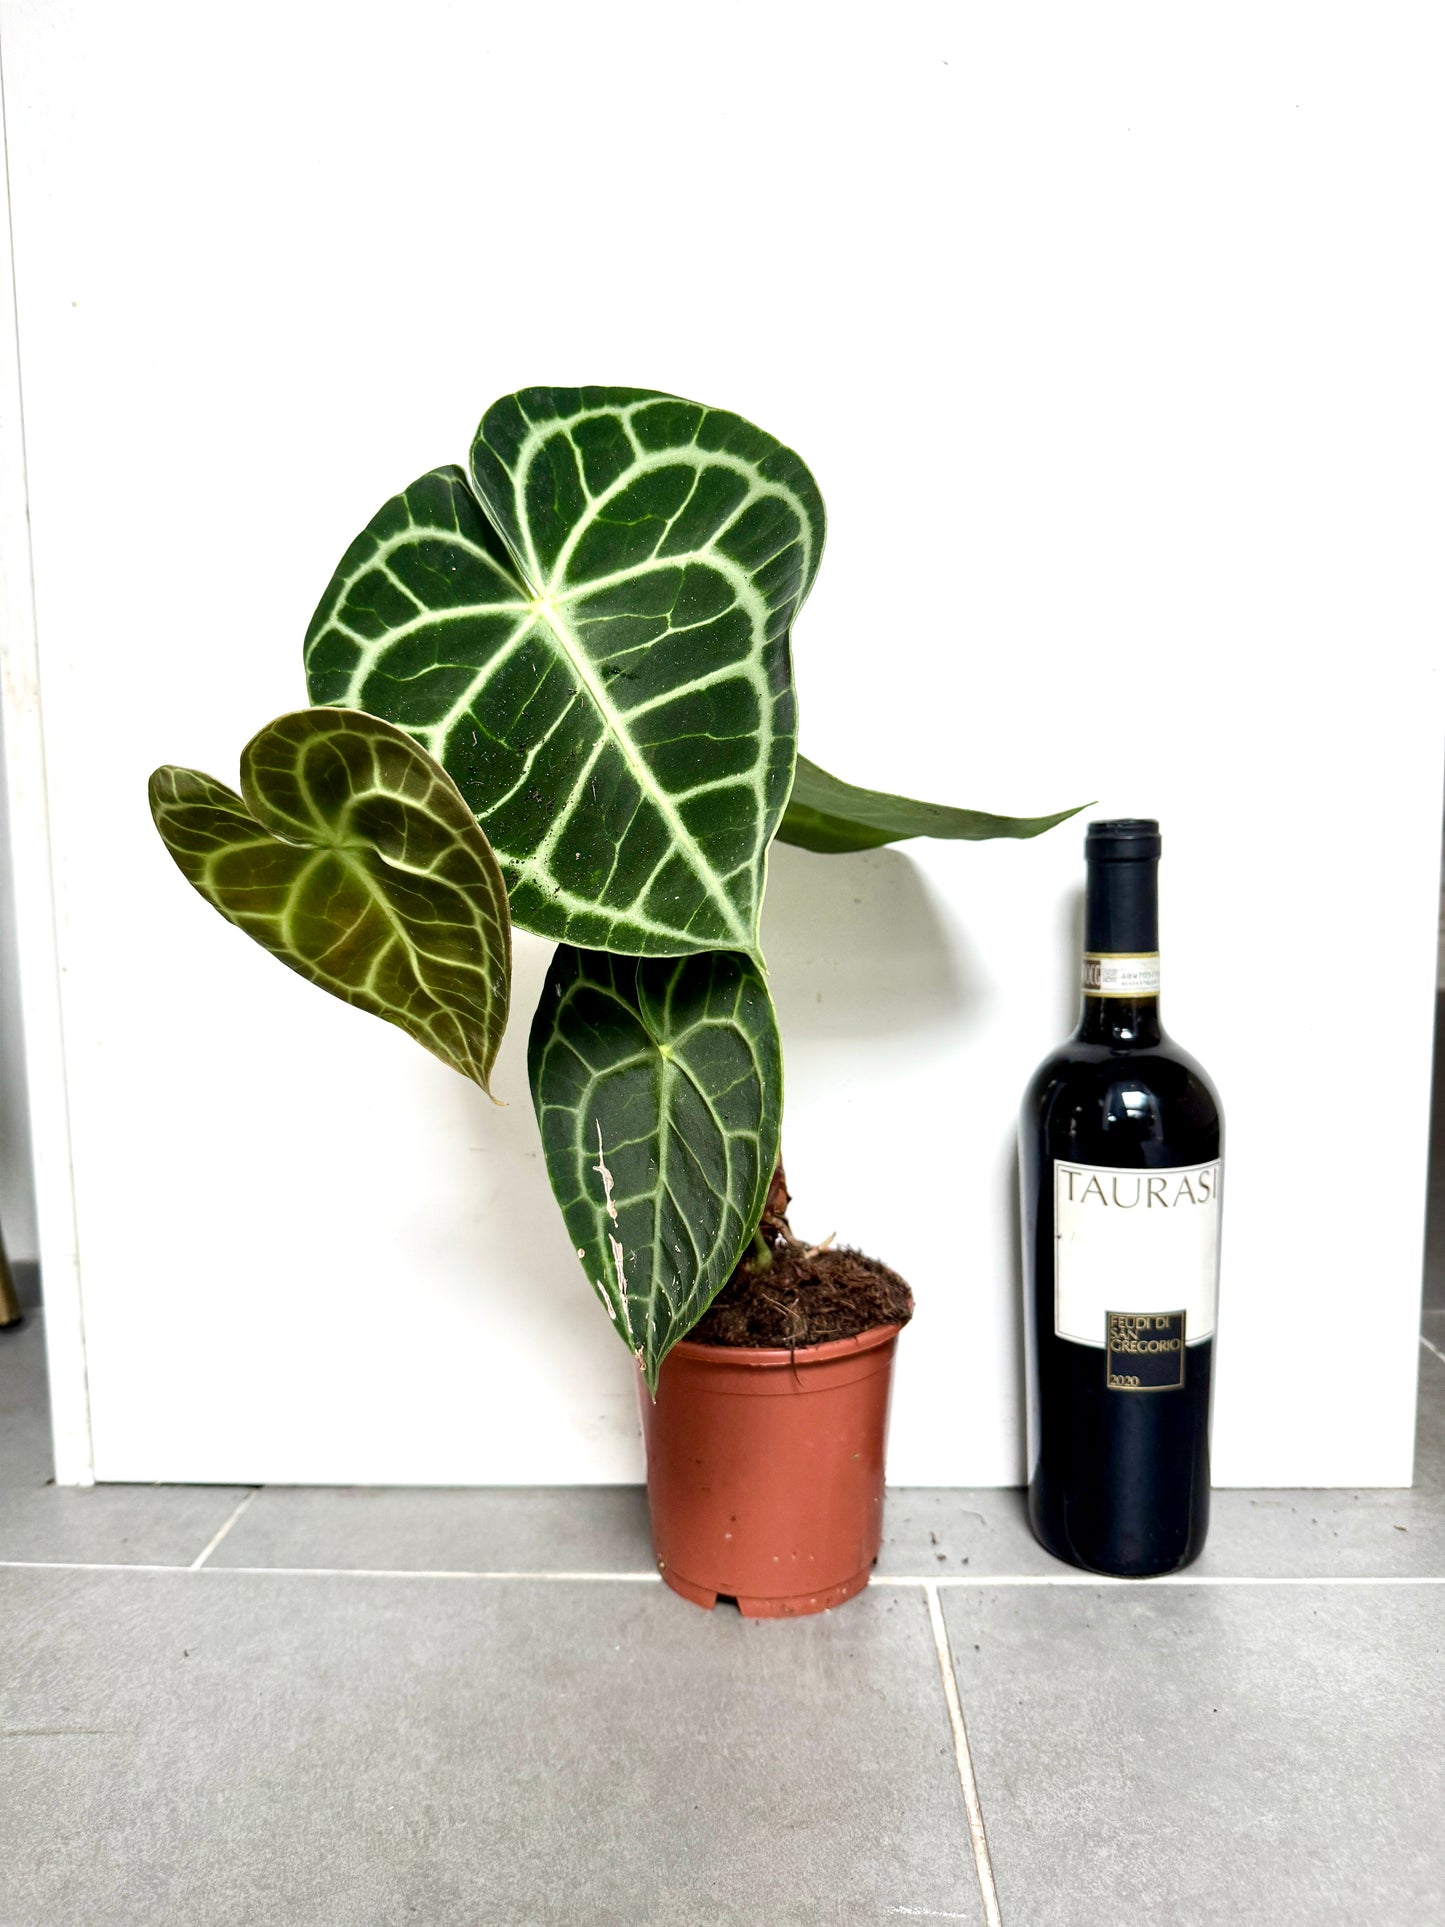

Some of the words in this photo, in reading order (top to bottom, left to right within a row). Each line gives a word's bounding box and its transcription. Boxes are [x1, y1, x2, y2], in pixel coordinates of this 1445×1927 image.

[1061, 1168, 1217, 1208] TAURASI
[1110, 1316, 1151, 1329] FEUDI
[1156, 1317, 1169, 1328] DI
[1110, 1327, 1138, 1340] SAN
[1110, 1338, 1180, 1353] GREGORIO
[1110, 1375, 1139, 1386] 2020
